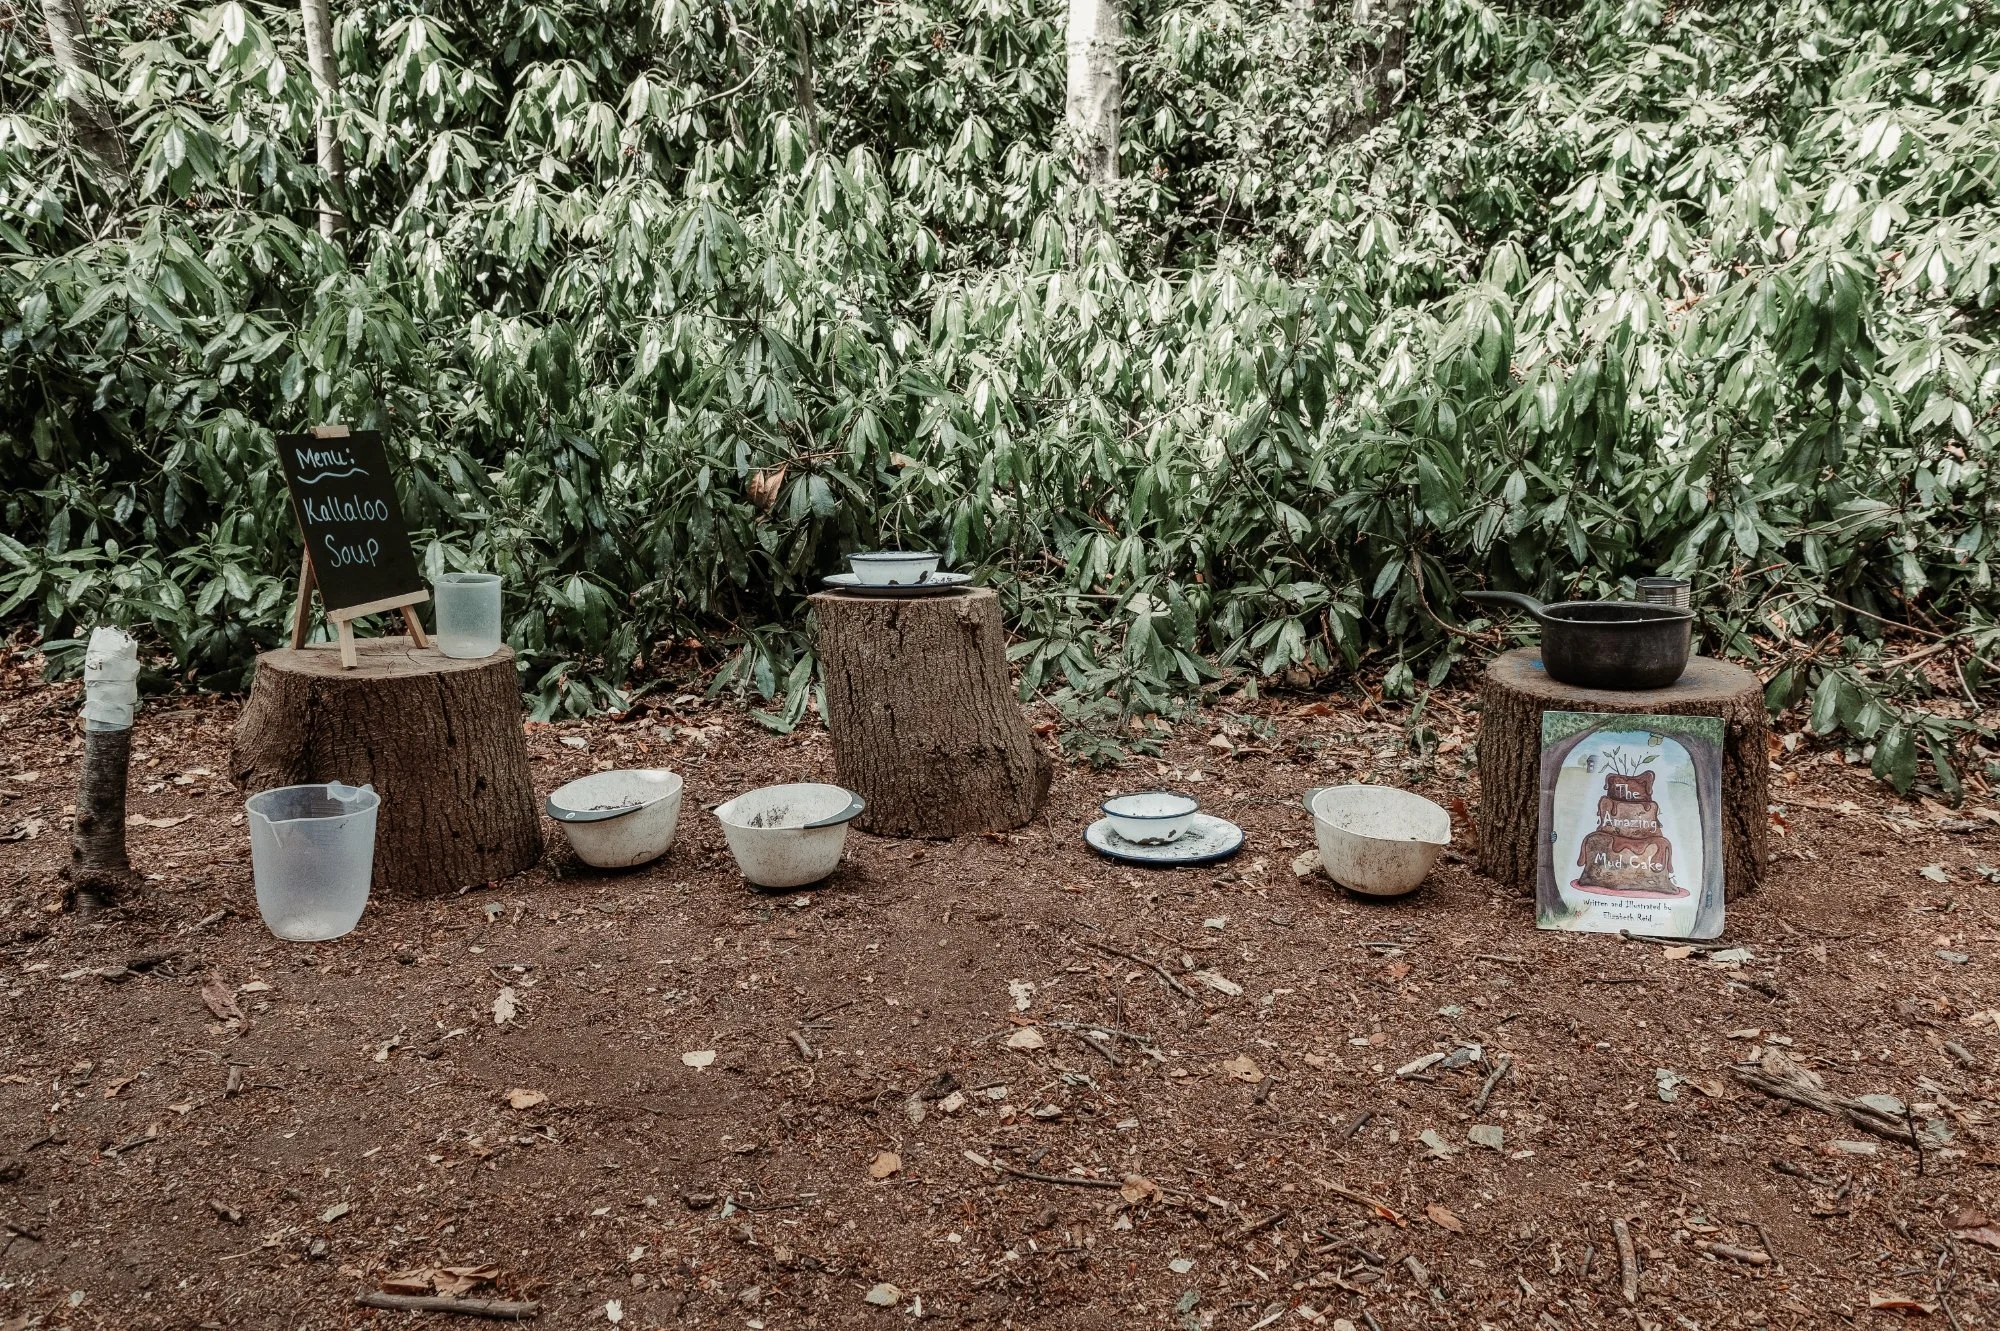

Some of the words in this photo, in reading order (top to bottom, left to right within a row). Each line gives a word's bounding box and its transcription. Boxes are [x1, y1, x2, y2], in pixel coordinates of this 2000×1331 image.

[295, 447, 355, 470] Menu:
[302, 494, 389, 525] Kallaloo
[324, 534, 379, 568] Soup
[1615, 783, 1640, 800] The
[1602, 810, 1657, 833] Amazing
[1594, 852, 1622, 869] Mud
[1629, 855, 1663, 872] Cake
[1583, 899, 1609, 907] Written
[1611, 900, 1623, 908] and
[1625, 900, 1661, 911] Illustrated
[1664, 903, 1672, 913] by
[1603, 911, 1634, 921] Elizabeth
[1638, 913, 1652, 922] Reid
